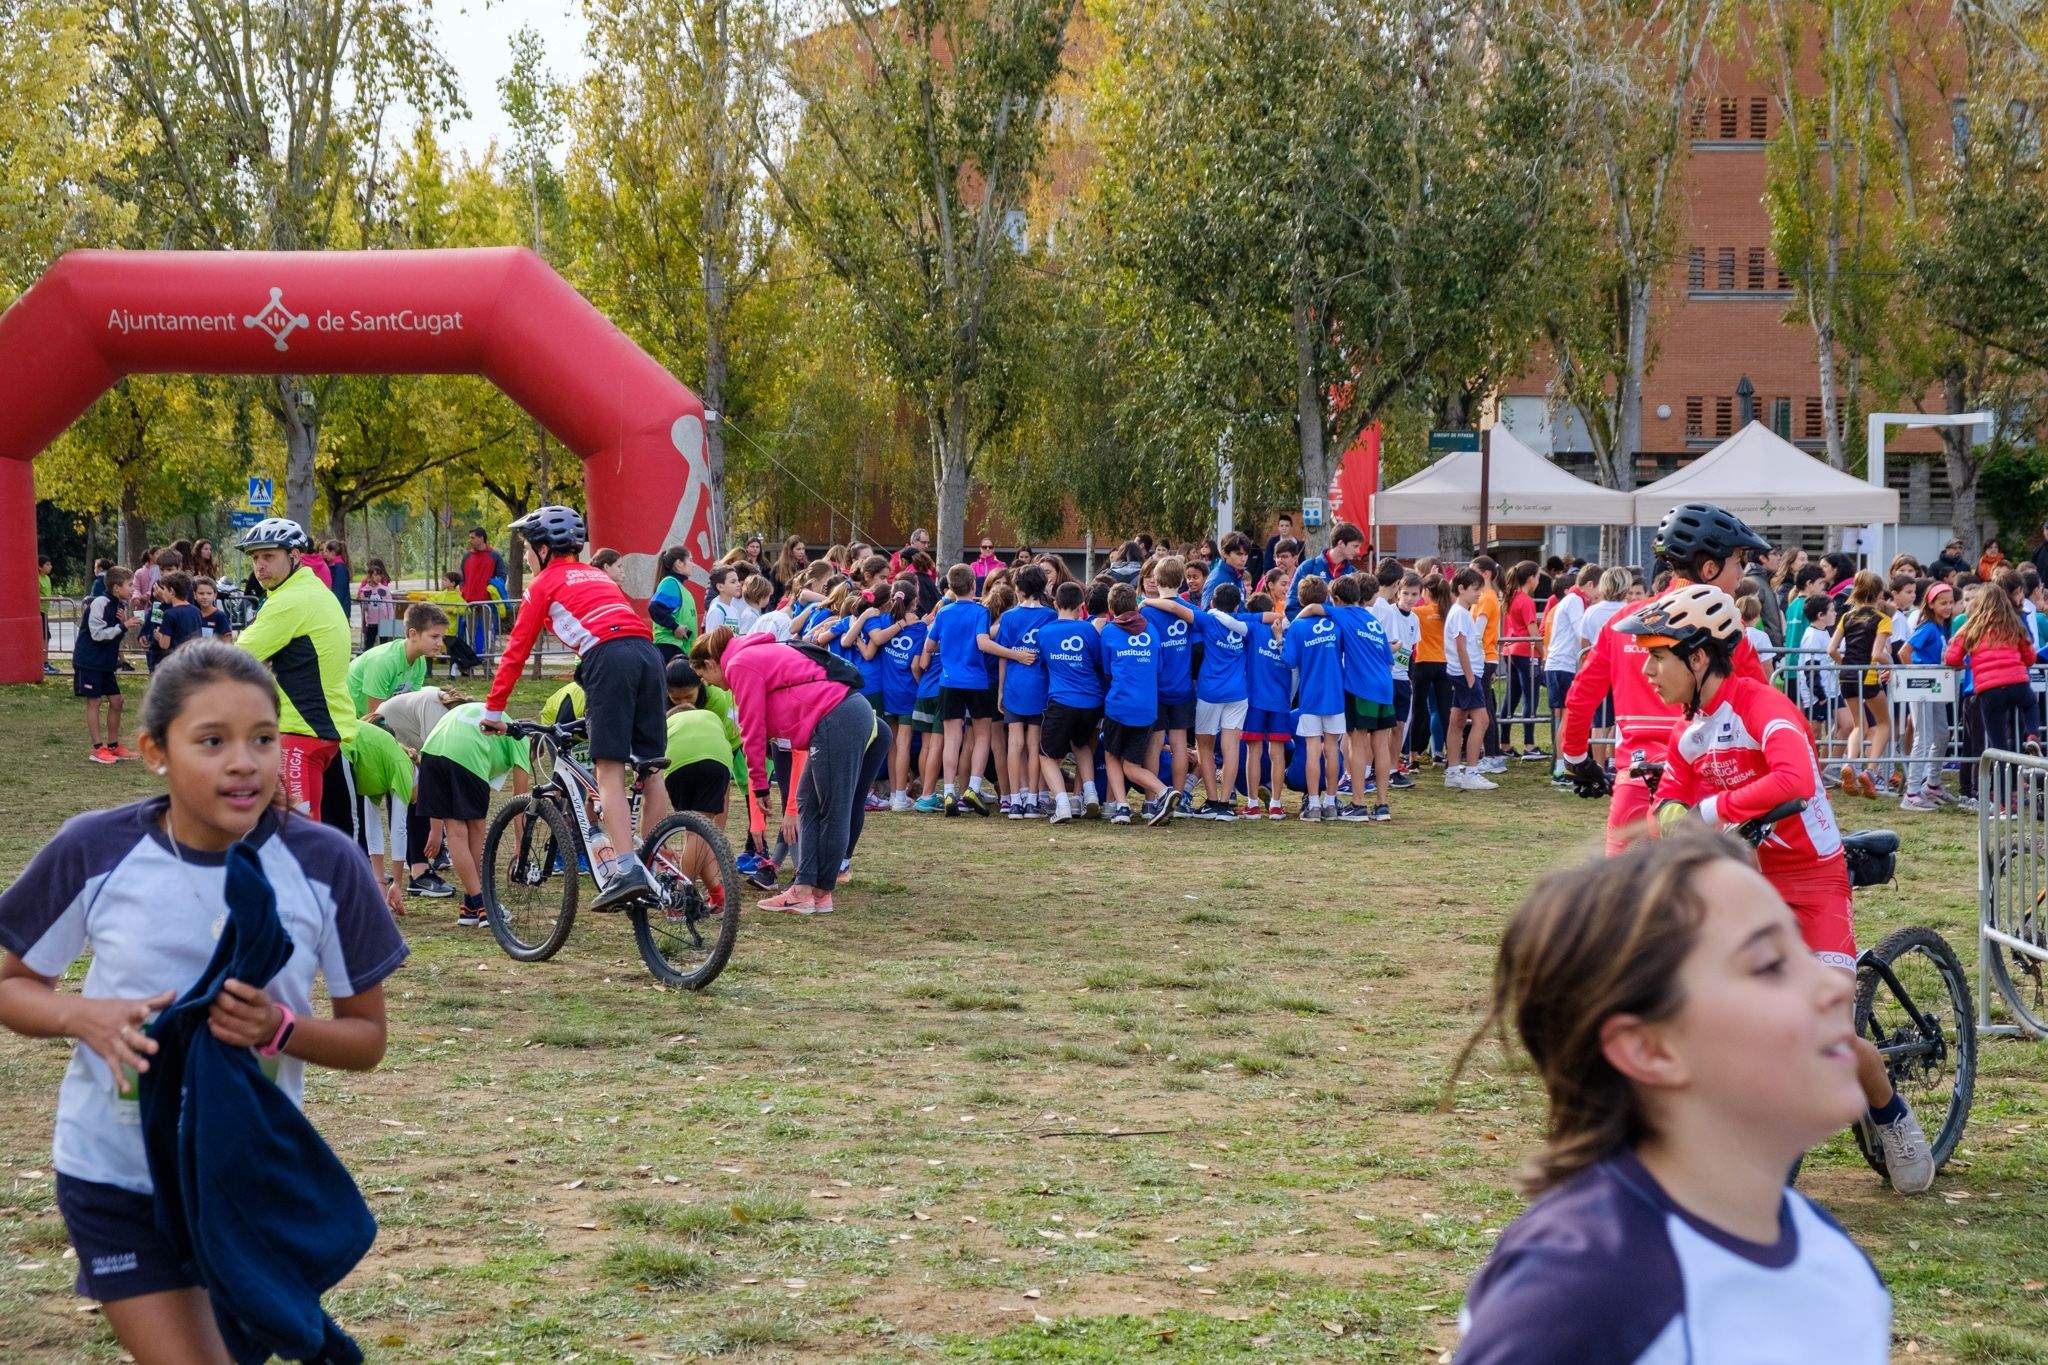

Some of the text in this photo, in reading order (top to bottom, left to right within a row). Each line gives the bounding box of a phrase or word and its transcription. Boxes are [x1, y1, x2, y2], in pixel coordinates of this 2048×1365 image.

[107, 309, 463, 335] Ajuntament de SantCugat
[1462, 503, 1494, 511] Ajuntant
[1161, 637, 1187, 647] nstitució
[1304, 634, 1336, 647] institució
[1050, 652, 1082, 662] institució
[1117, 648, 1151, 657] institució
[290, 747, 304, 778] CUGAT
